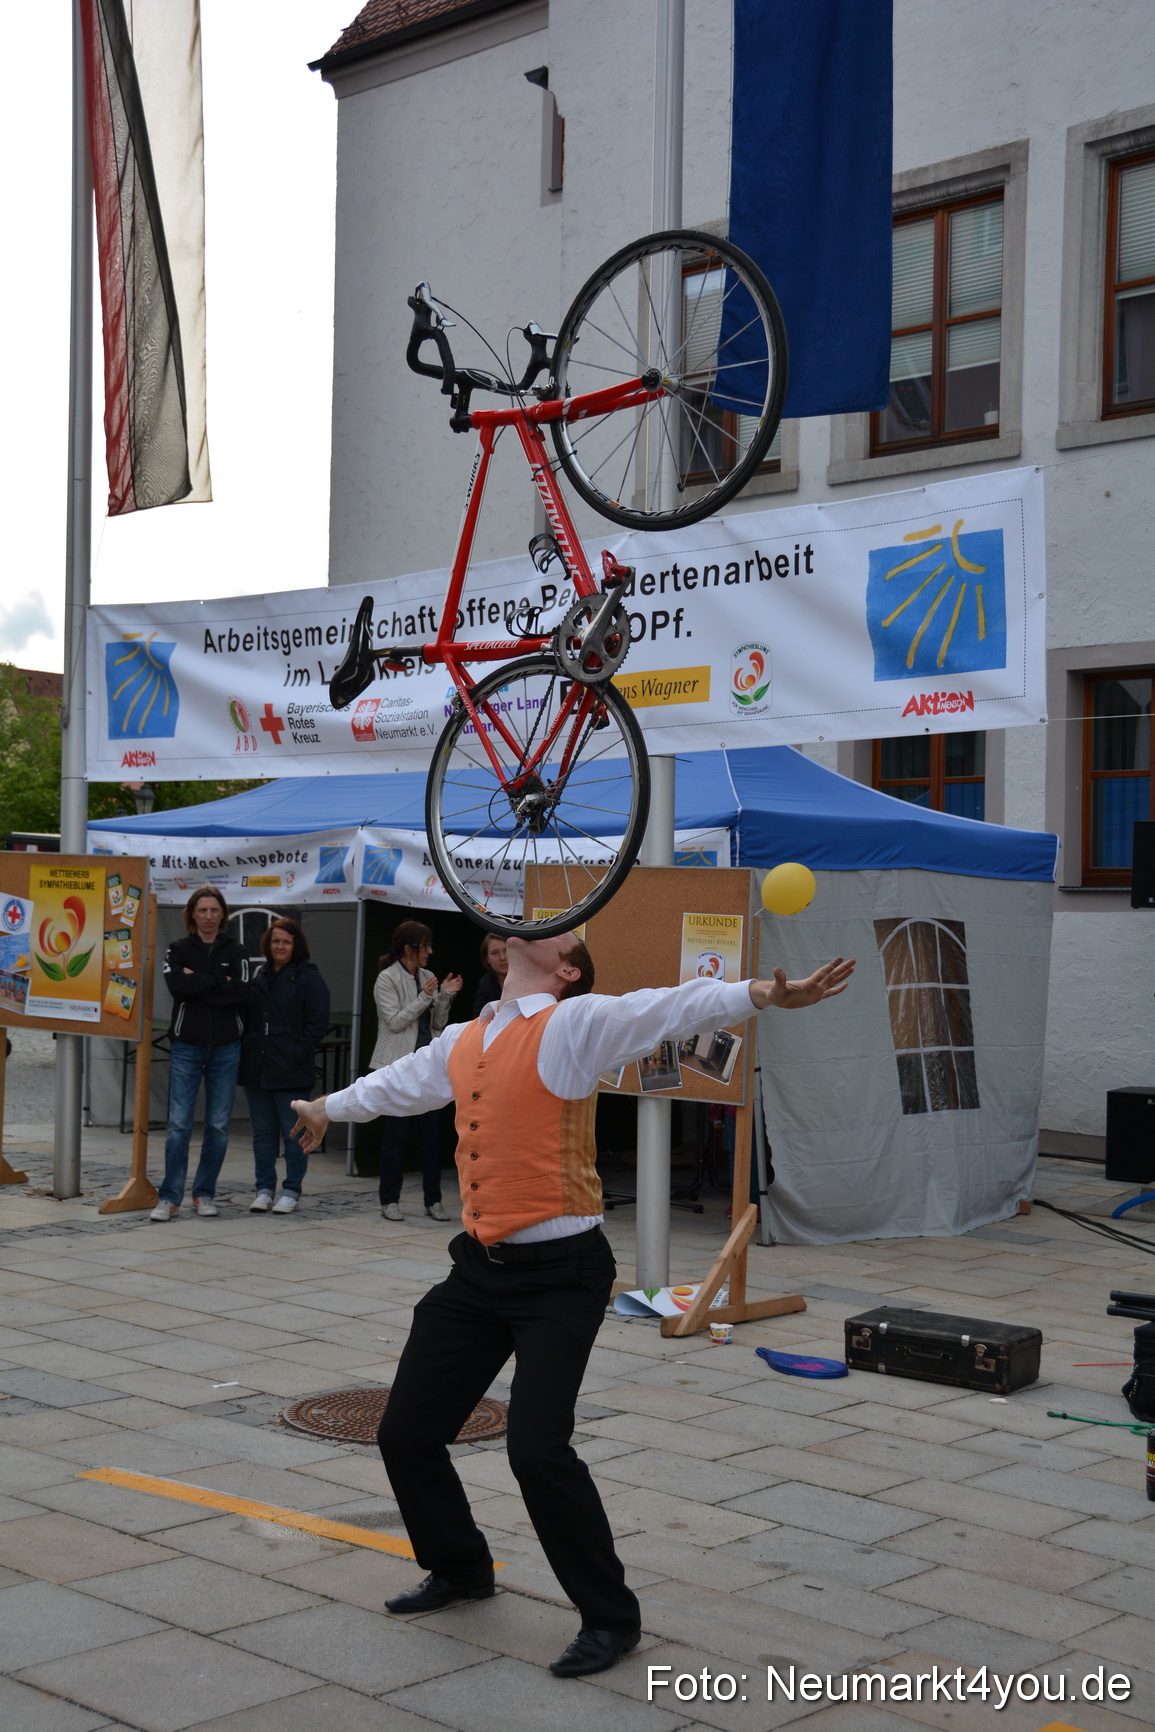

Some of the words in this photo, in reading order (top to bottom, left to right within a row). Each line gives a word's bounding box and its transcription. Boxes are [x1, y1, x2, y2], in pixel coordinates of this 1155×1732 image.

[464, 639, 520, 651] SPECIALIZED
[283, 663, 311, 687] im
[641, 678, 700, 701] Wagner
[375, 709, 429, 723] Sozialstation
[288, 717, 315, 730] Rotes
[292, 731, 321, 744] Kreuz
[375, 726, 419, 740] Neumarkt
[420, 723, 438, 737] e.V.
[235, 849, 309, 868] Angebote
[50, 869, 90, 879] WETTBEWERB
[39, 880, 96, 891] SYMPATHIEBLUME
[688, 916, 738, 928] URKUNDE
